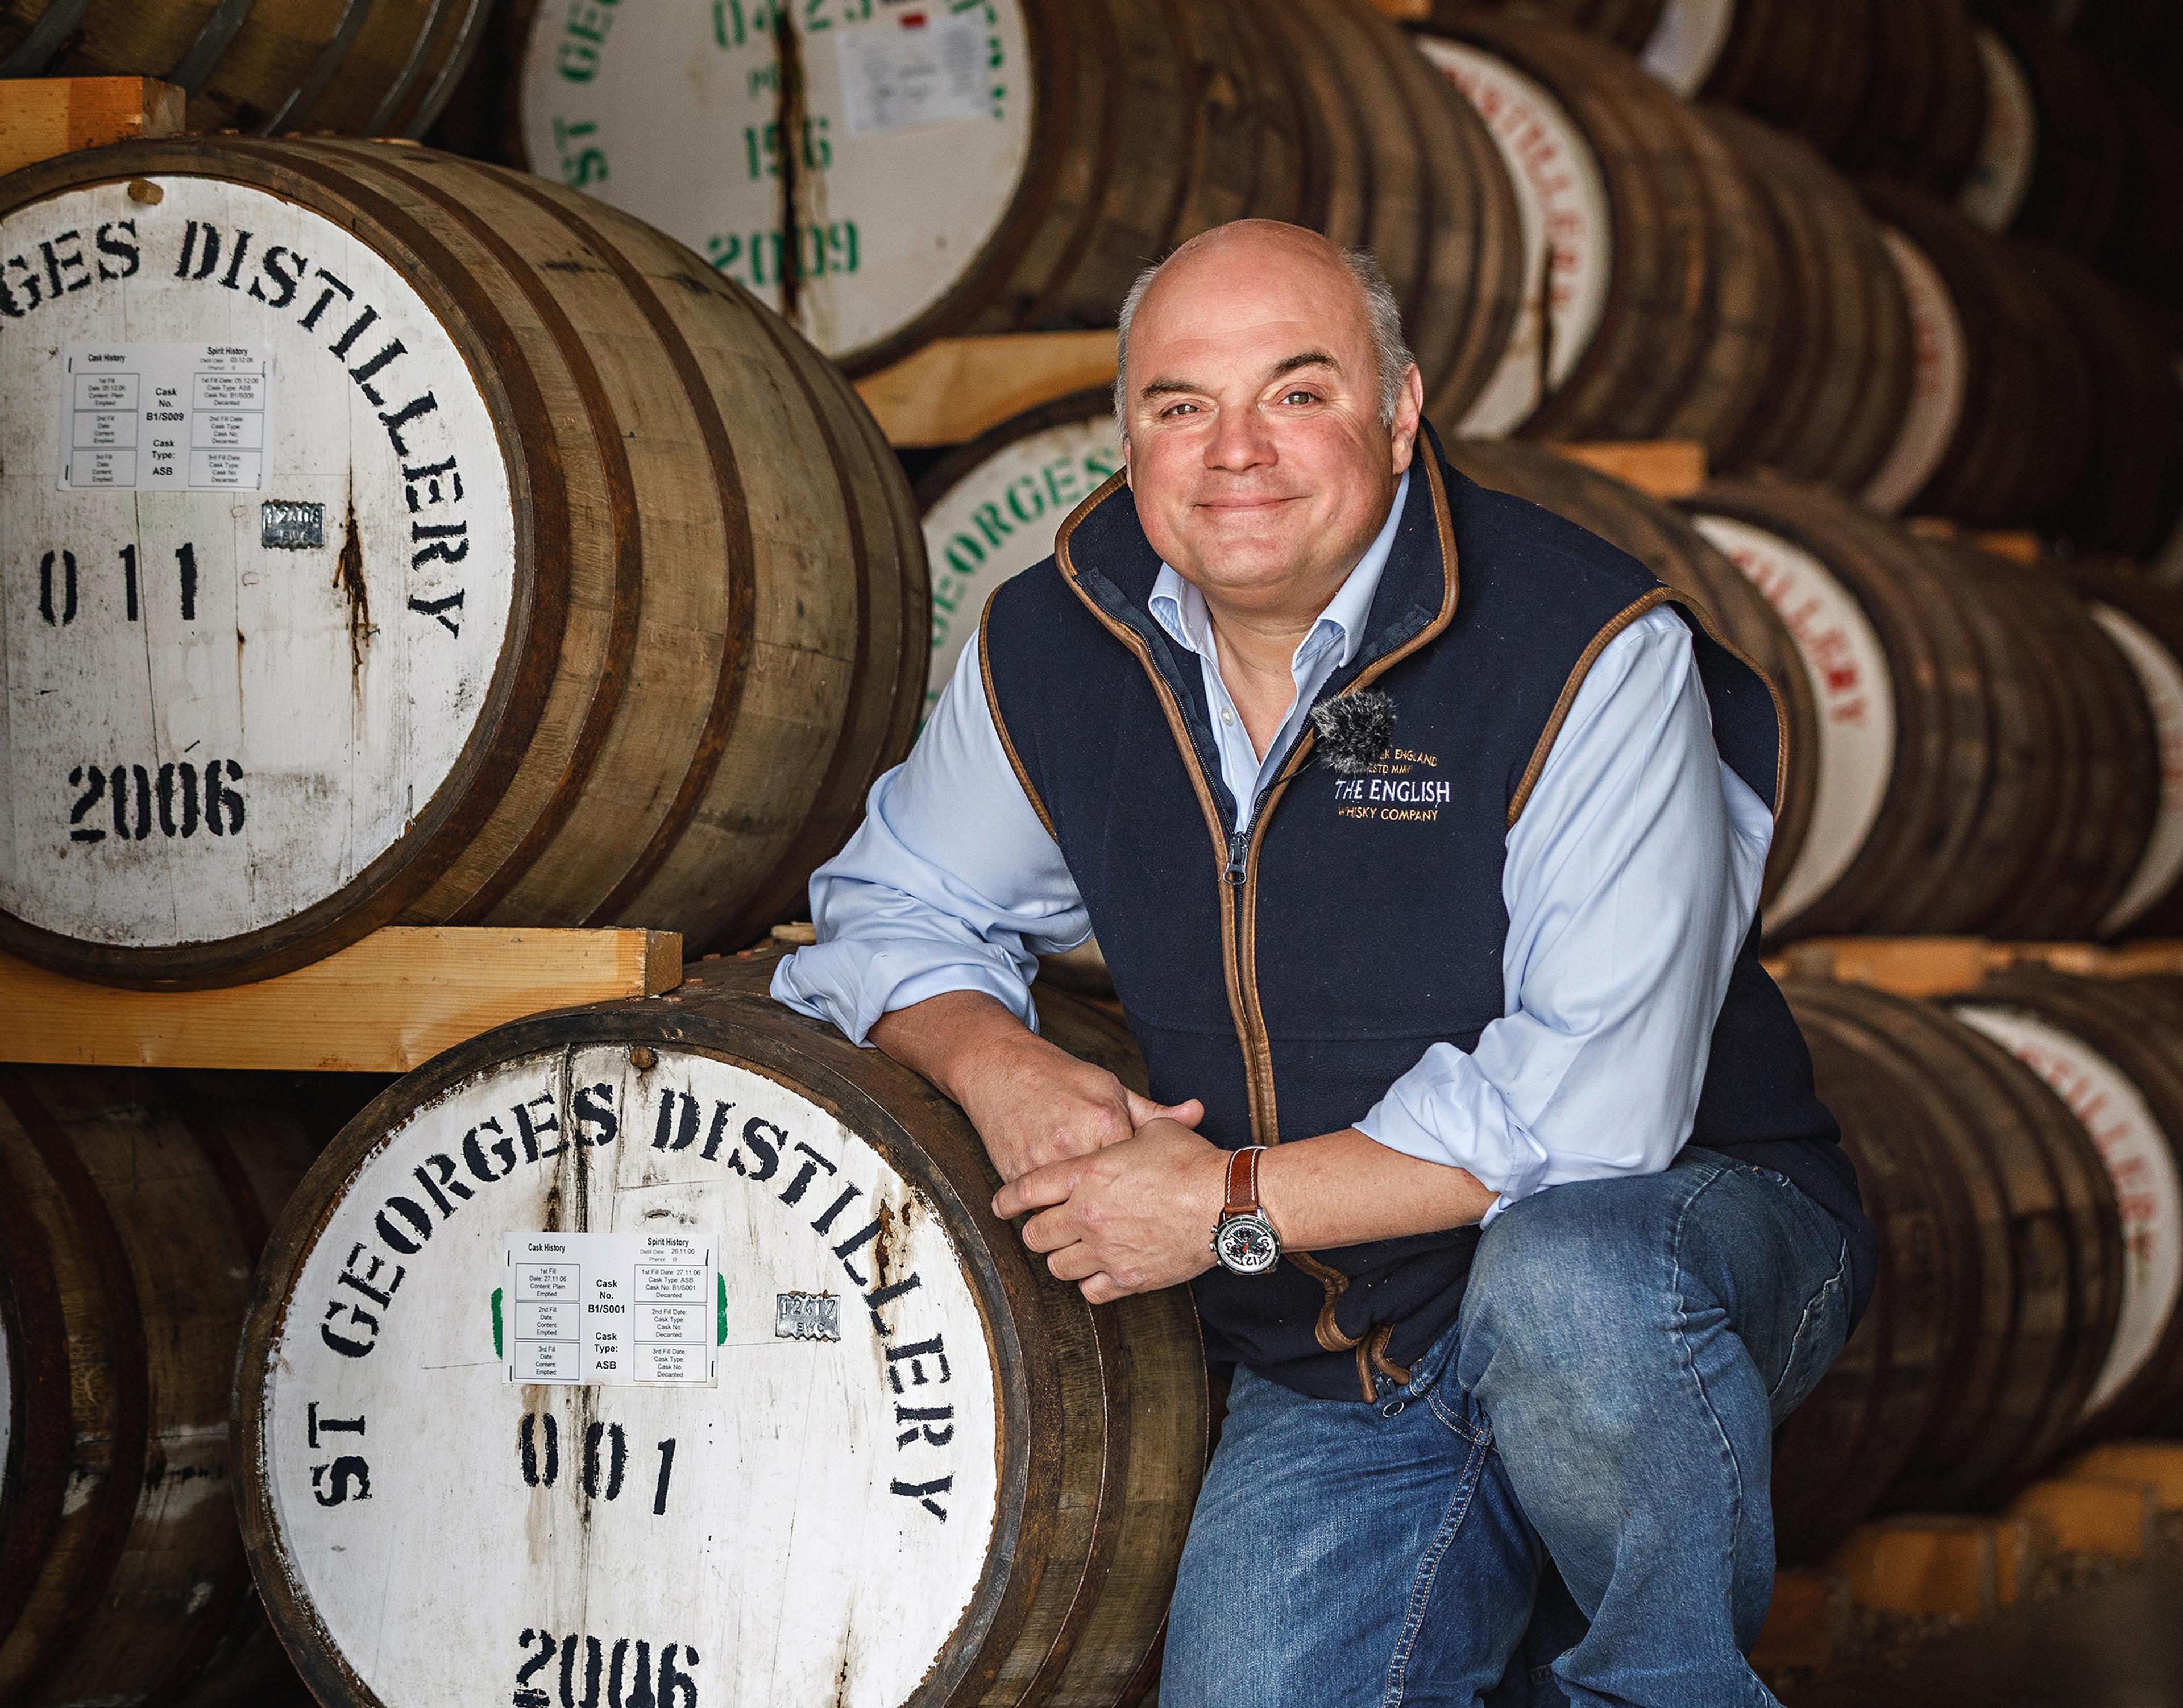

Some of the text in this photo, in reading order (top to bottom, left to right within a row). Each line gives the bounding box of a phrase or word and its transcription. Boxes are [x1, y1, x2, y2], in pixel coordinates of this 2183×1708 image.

[207, 346, 248, 356] Spirit History
[155, 388, 177, 396] Cask
[146, 413, 184, 422] B1/S009
[175, 220, 469, 638] DISTILLERY
[152, 451, 175, 461] Type:
[153, 467, 173, 476] ASB
[1395, 749, 1437, 766] ENGLAND
[1335, 778, 1450, 802] THE ENGLISH
[69, 759, 245, 845] 2006
[1338, 806, 1438, 822] WHISKY COMPANY
[648, 1237, 690, 1248] Spirit History
[544, 1243, 566, 1254] History
[1246, 1255, 1257, 1266] 12
[308, 1083, 957, 1523] ST GEORGES DISTILLERY
[588, 1304, 625, 1313] B1/S001
[795, 1322, 825, 1332] EWC
[595, 1332, 617, 1341] Cask
[594, 1344, 619, 1354] Type:
[596, 1361, 617, 1369] ASB
[520, 1412, 677, 1515] 001
[512, 1627, 700, 1708] 2006
